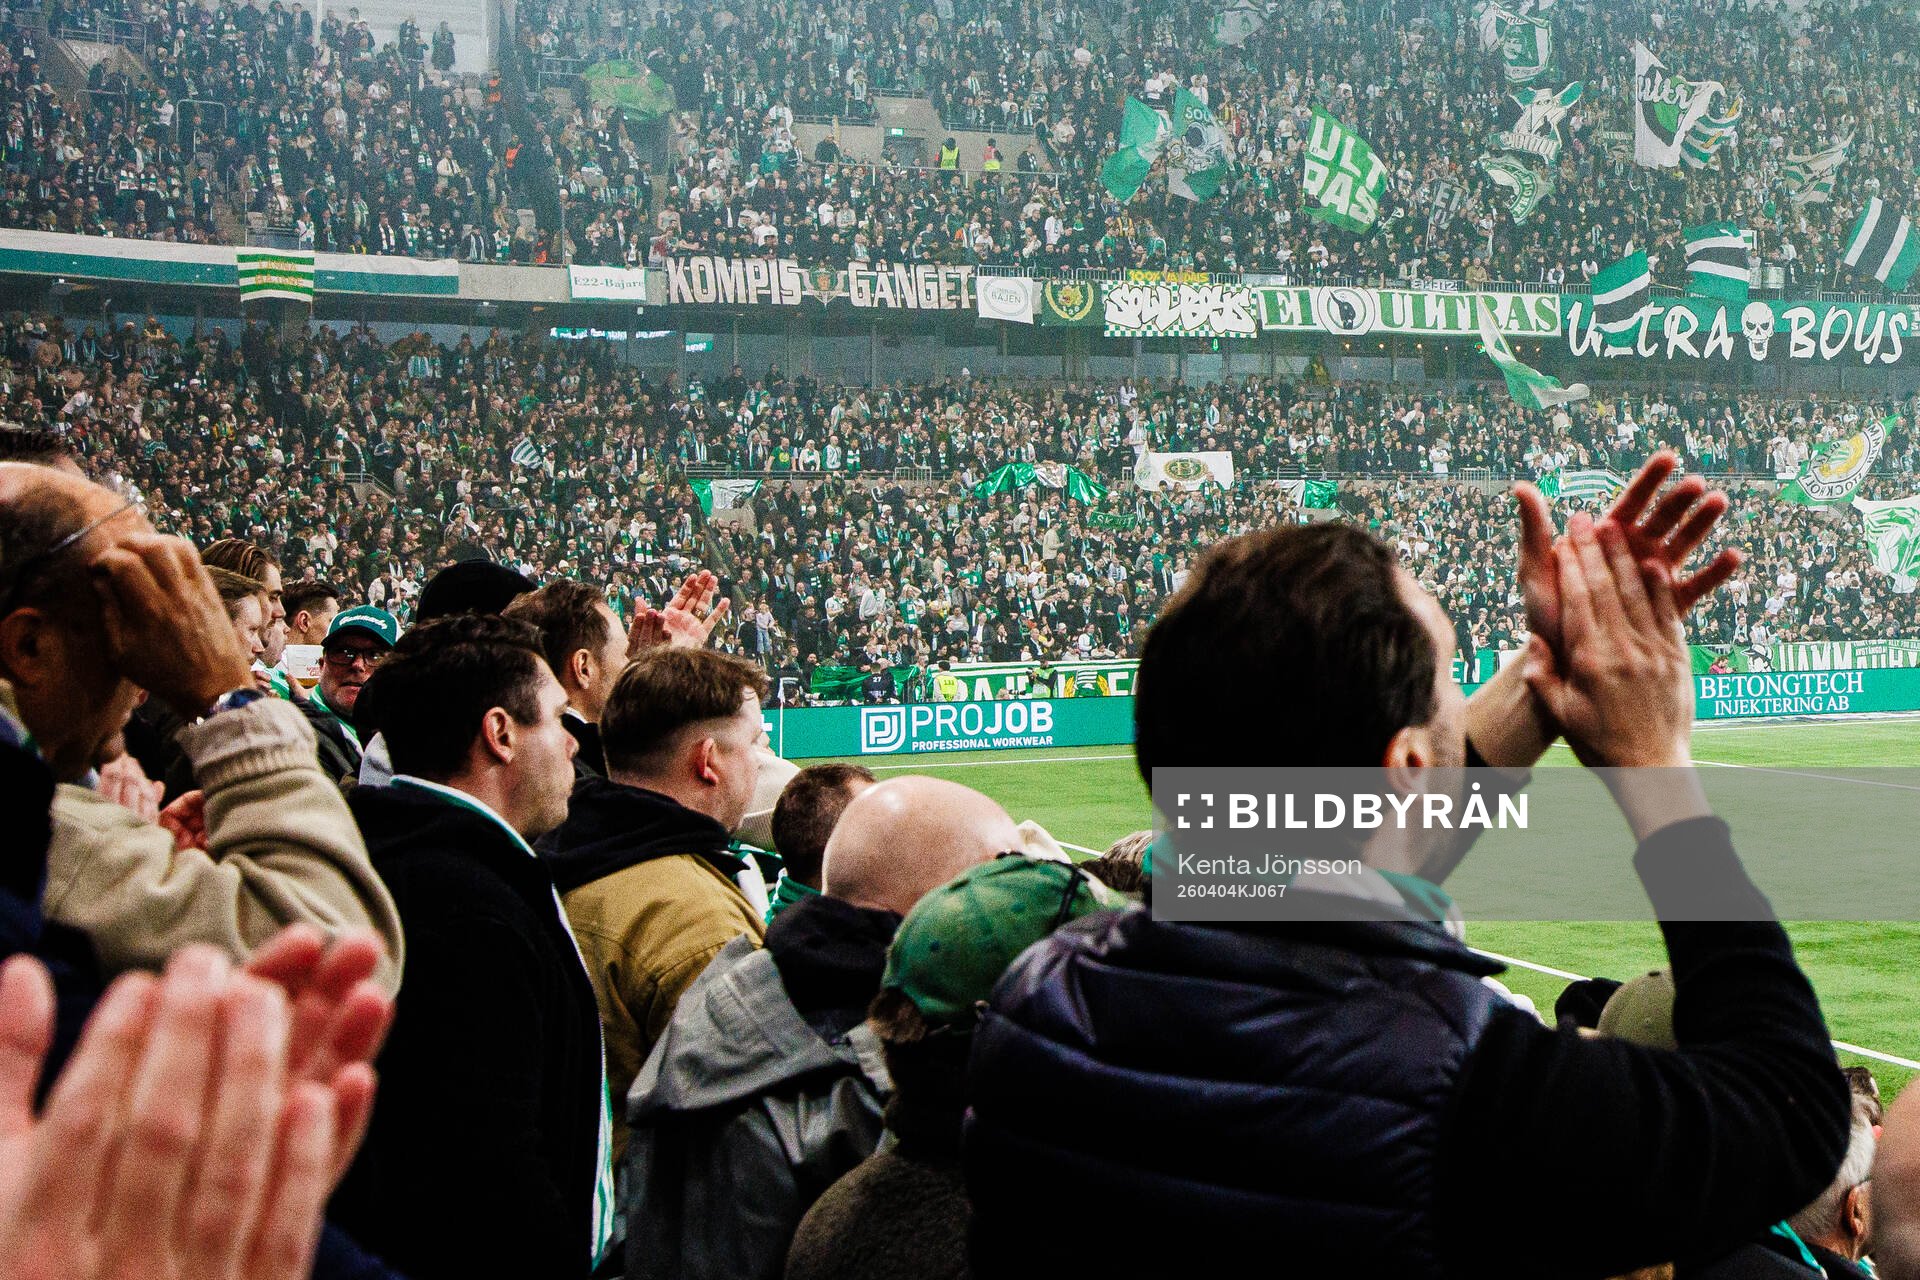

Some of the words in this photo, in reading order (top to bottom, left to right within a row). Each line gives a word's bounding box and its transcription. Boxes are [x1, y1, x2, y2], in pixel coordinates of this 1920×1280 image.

[667, 256, 801, 306] KOMPIS
[849, 261, 974, 310] GÄNGET
[1378, 291, 1558, 333] ULTRAS
[1782, 305, 1909, 364] BOYS
[1700, 671, 1864, 699] BETONGTECH
[911, 701, 1054, 738] PROJOB
[1714, 697, 1823, 716] INJEKTERING
[1826, 695, 1850, 712] AB
[912, 739, 991, 751] PROFESSIONAL
[992, 736, 1053, 748] WORKWEAR
